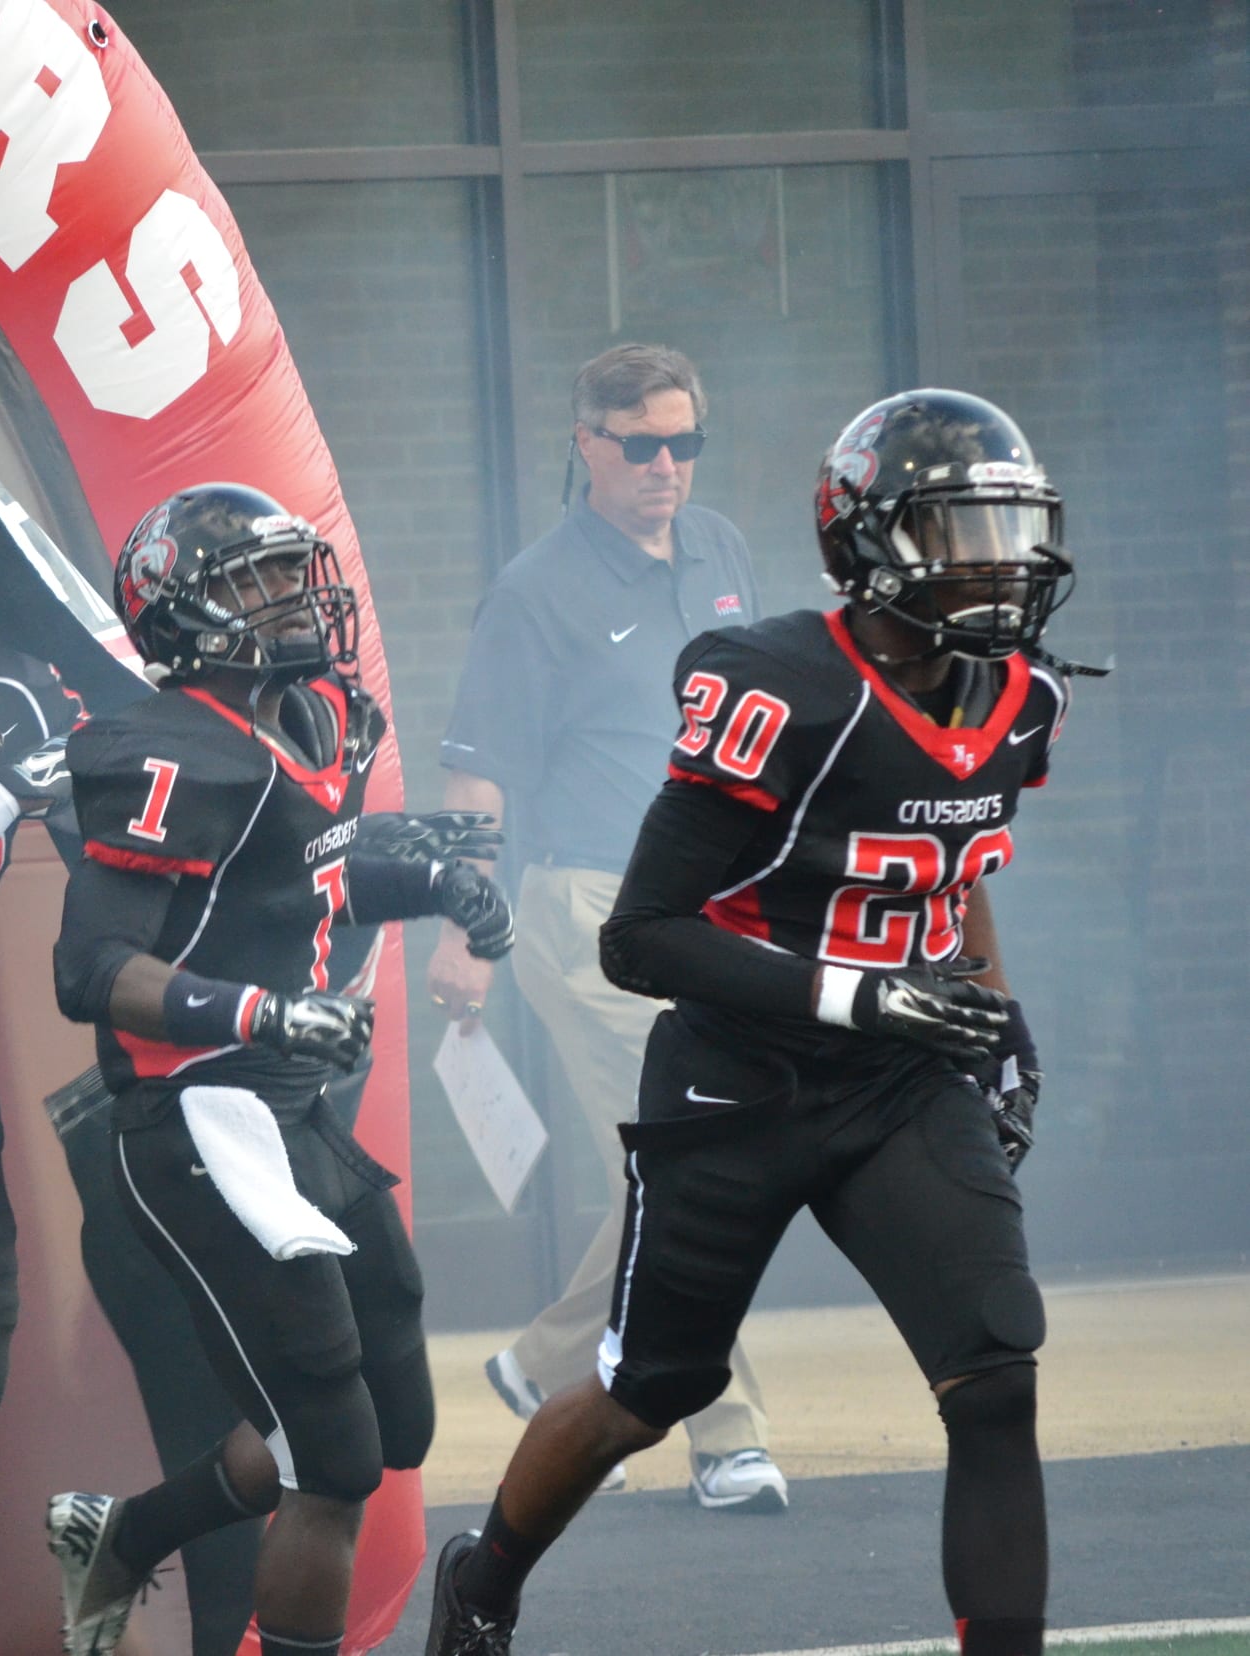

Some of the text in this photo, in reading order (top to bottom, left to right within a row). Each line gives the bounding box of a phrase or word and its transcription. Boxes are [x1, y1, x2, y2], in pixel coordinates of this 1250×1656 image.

[672, 670, 791, 780] 20
[126, 757, 181, 843] 1
[817, 824, 1014, 969] 20
